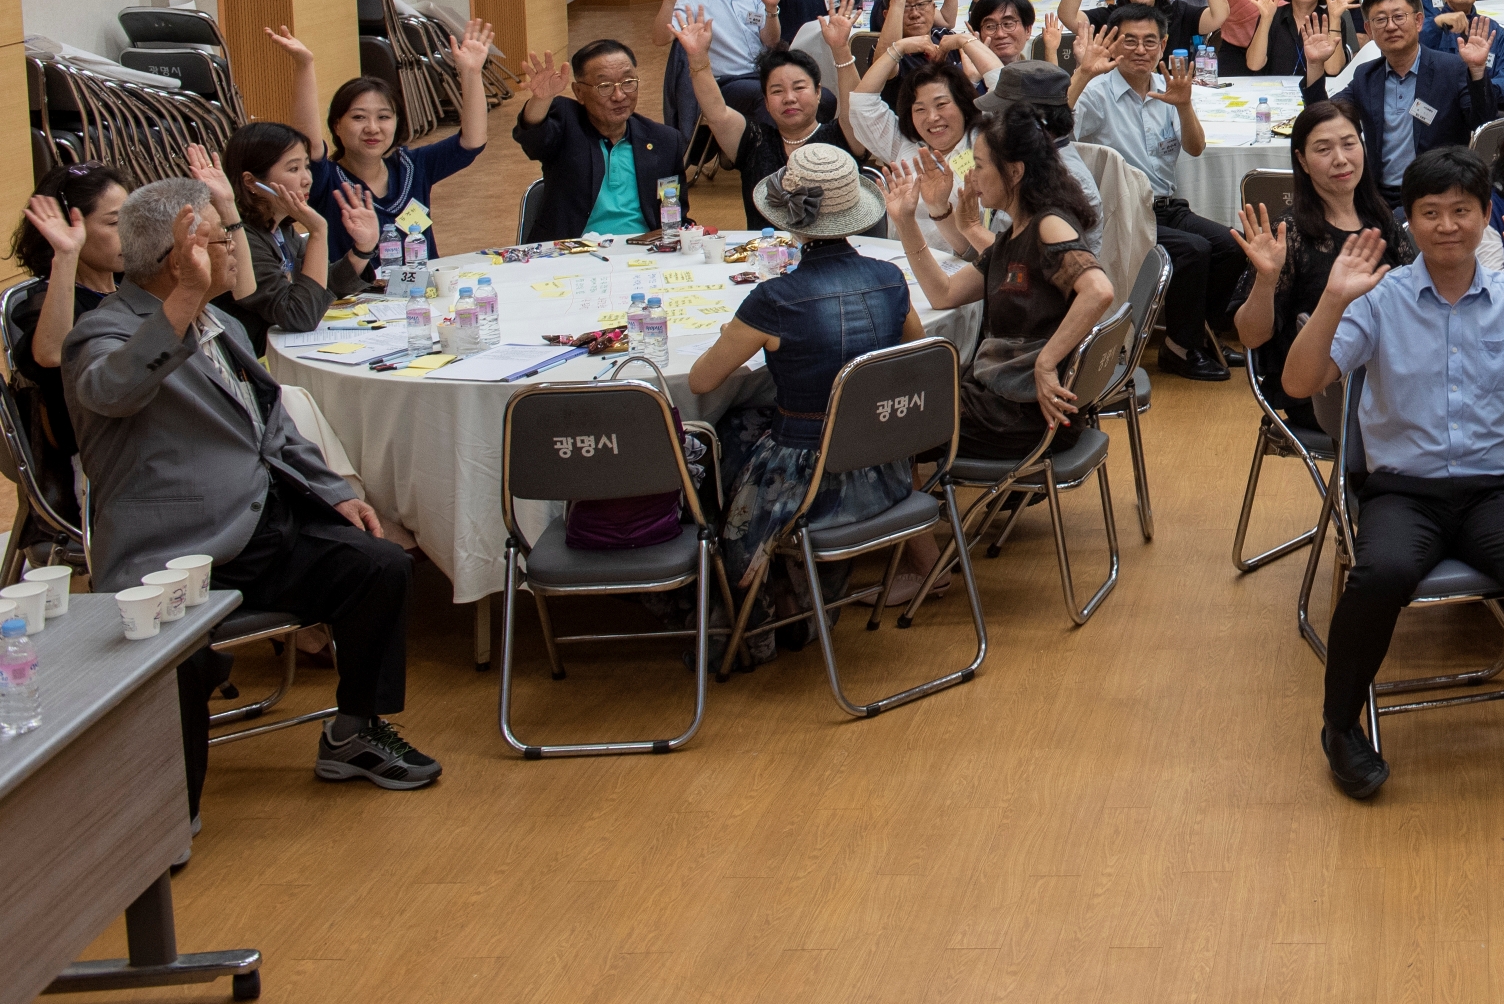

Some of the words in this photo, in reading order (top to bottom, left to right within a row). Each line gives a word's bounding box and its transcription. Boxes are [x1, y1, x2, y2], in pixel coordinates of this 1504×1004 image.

[148, 65, 182, 77] 광명시
[401, 271, 417, 283] 3조
[876, 390, 925, 422] 광명시
[552, 433, 619, 459] 광명시
